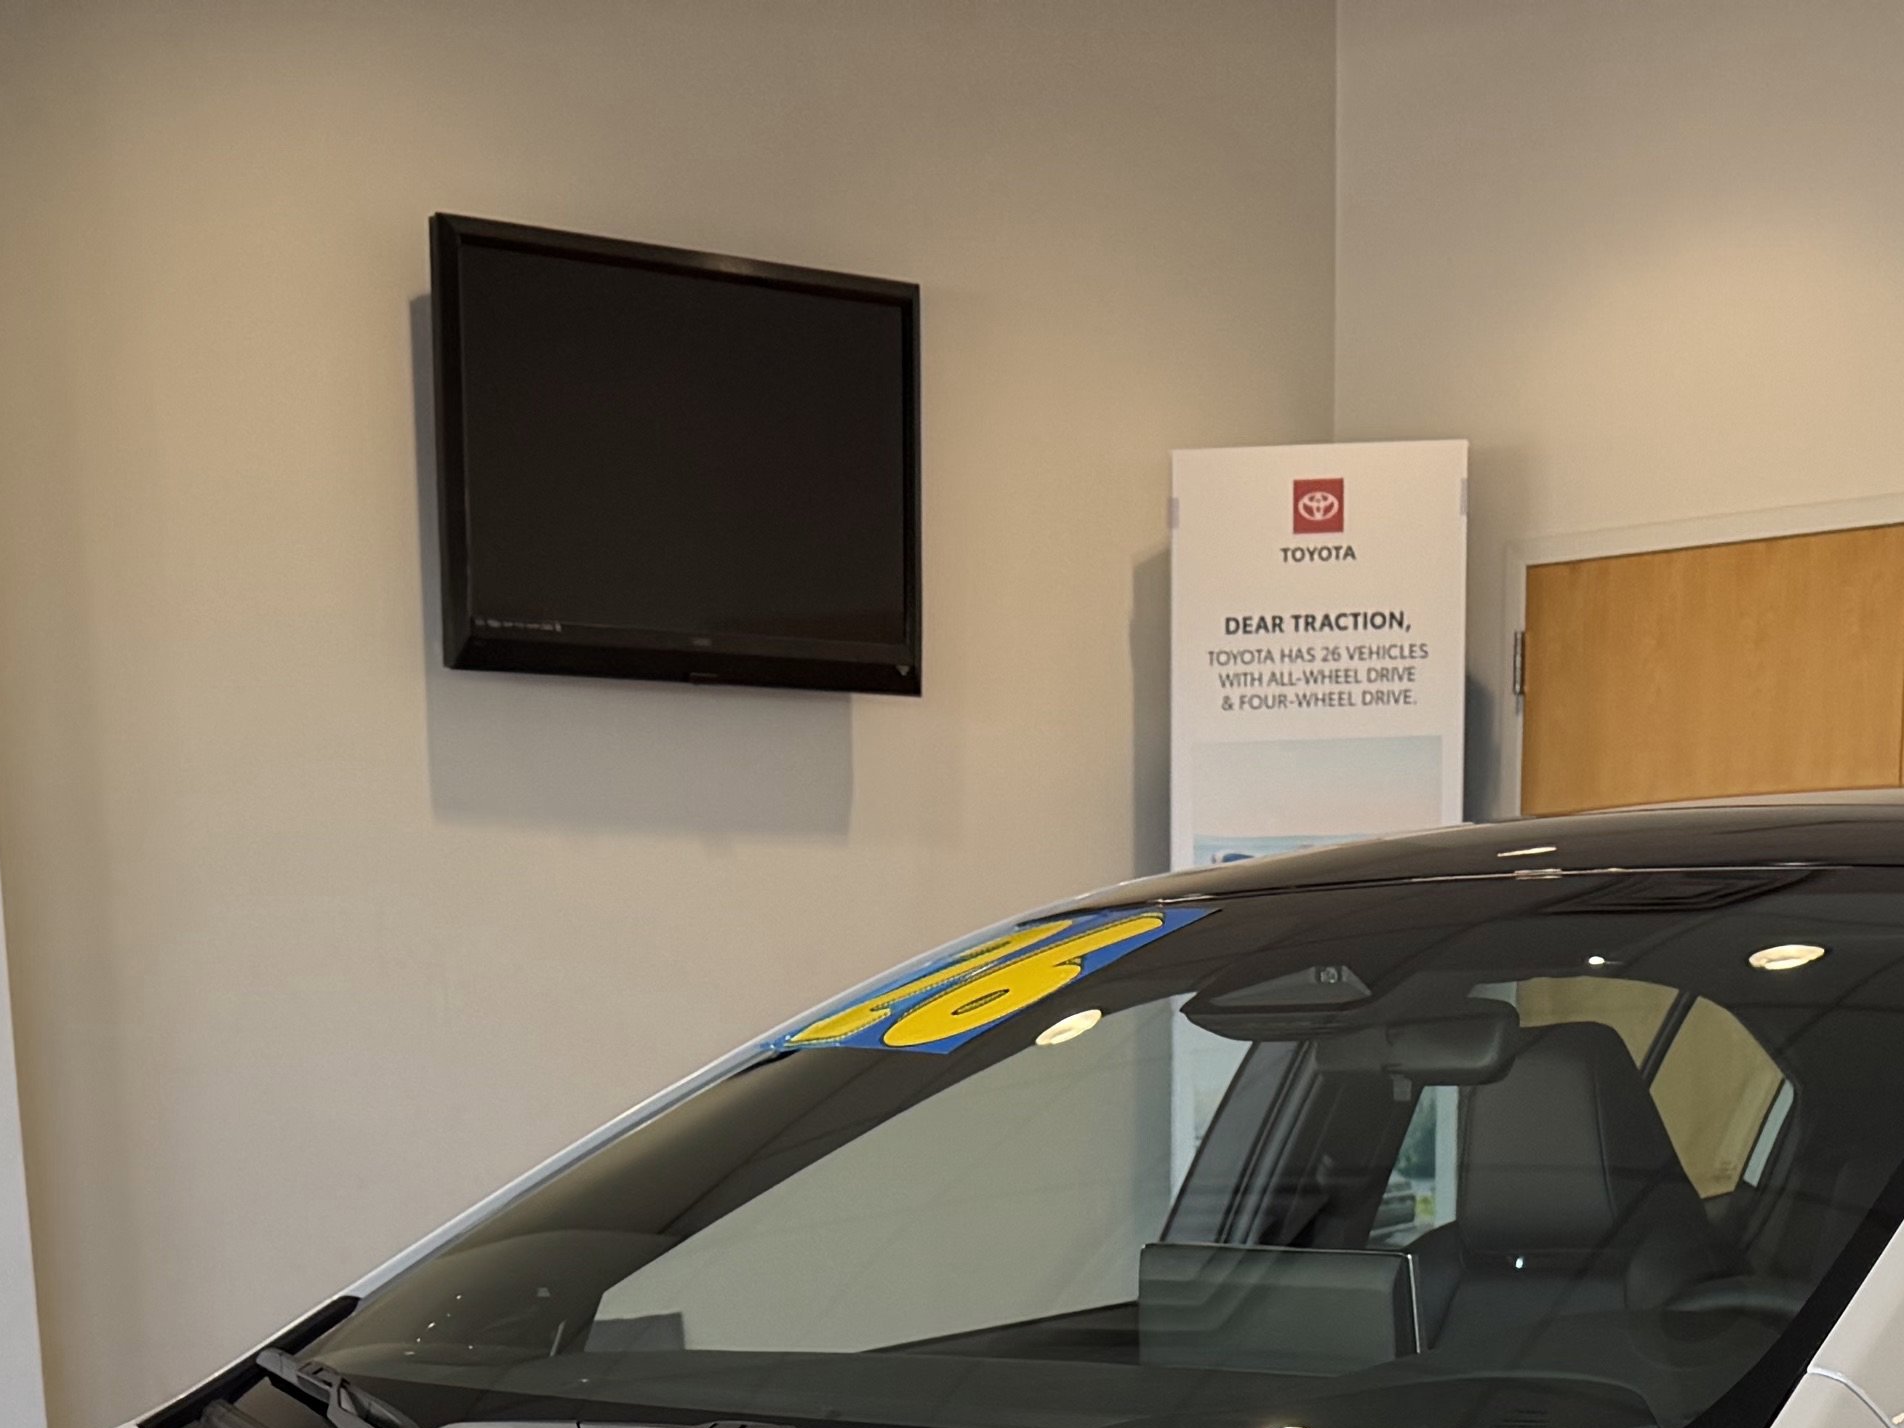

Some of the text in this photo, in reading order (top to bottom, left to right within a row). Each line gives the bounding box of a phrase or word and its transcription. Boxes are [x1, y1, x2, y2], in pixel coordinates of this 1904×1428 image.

[1280, 545, 1356, 562] TOYOTA
[1225, 611, 1411, 635] DEAR TRACTION,
[1208, 643, 1429, 666] TOYOTA HAS 26 VEHICLES
[1219, 666, 1416, 688] WITH ALL-WHEEL DRIVE
[1221, 689, 1418, 711] & FOUR-WHEEL DRIVE.
